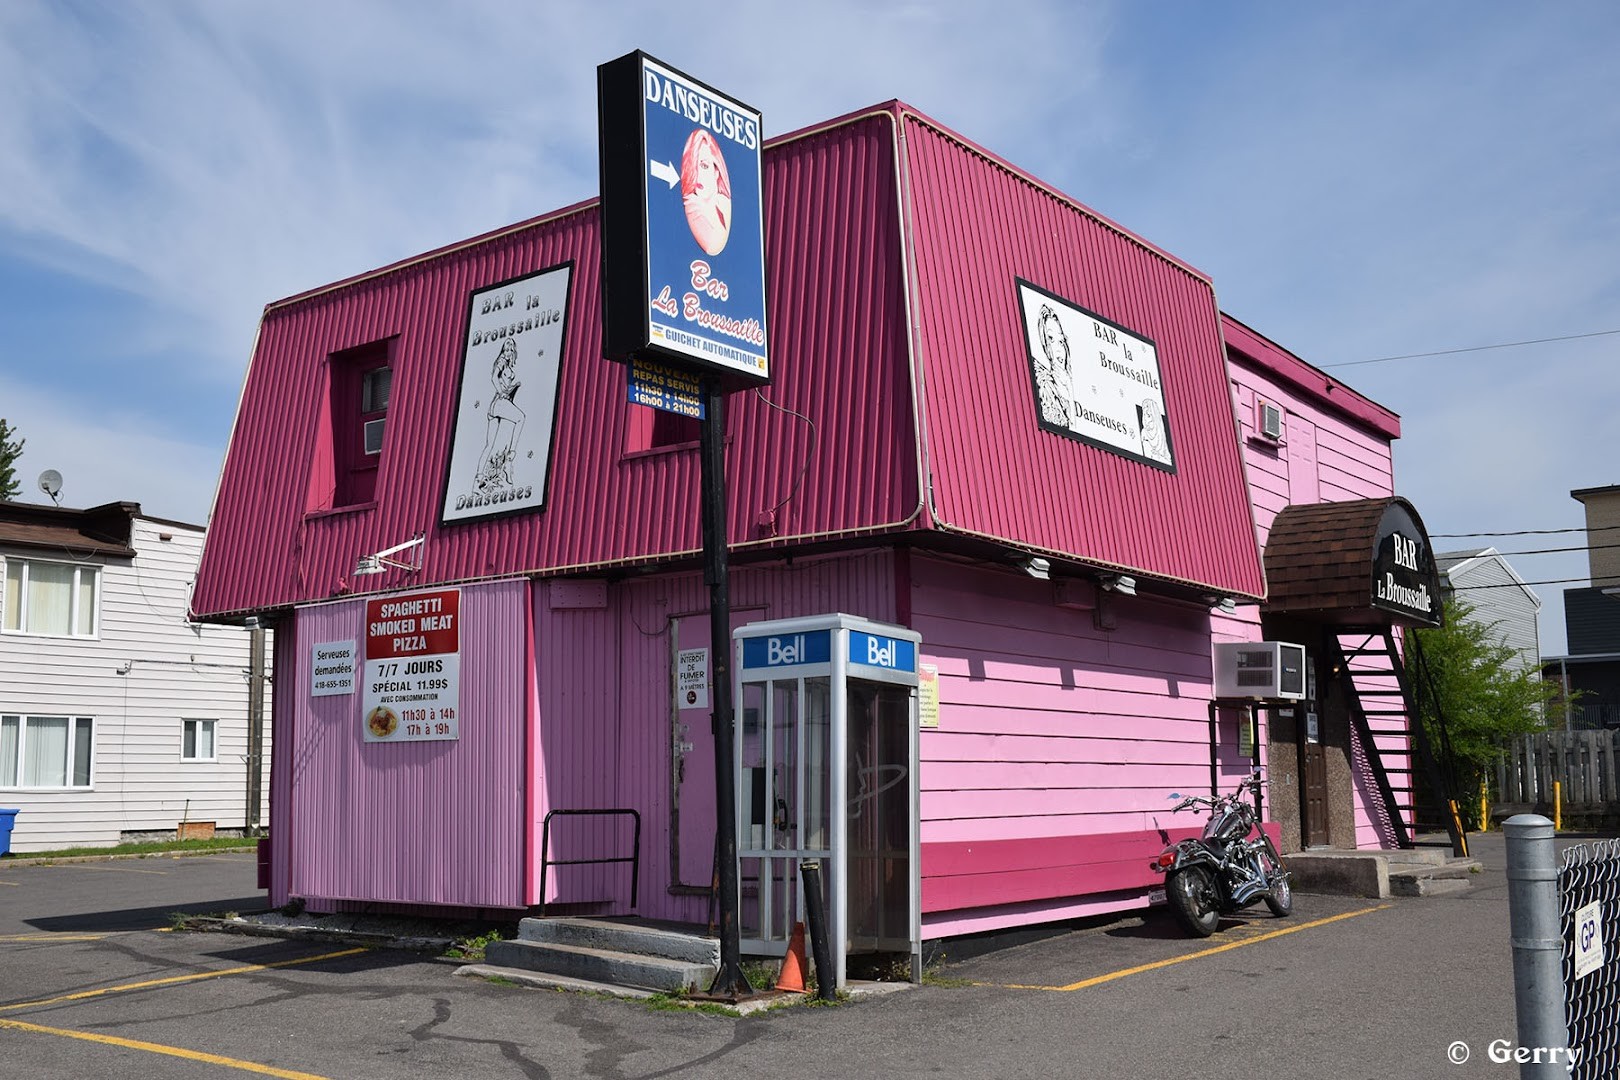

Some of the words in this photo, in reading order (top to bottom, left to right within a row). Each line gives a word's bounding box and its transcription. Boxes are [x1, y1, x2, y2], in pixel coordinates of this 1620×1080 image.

[645, 70, 757, 150] DANSEUSES
[690, 260, 729, 301] Bar
[481, 291, 514, 315] BAR
[526, 294, 540, 311] la
[472, 308, 560, 347] Broussaille
[652, 285, 678, 318] La
[683, 292, 765, 347] Broussaille
[665, 329, 701, 348] GUICHET
[702, 341, 757, 366] AUTOMATIQUE
[1093, 321, 1118, 347] BAR
[1123, 343, 1133, 362] la
[633, 369, 664, 385] REPAS
[667, 379, 700, 394] SERVIS
[1099, 351, 1159, 390] Broussaille
[634, 381, 663, 396] 11h30
[634, 392, 663, 407] 16h00
[673, 402, 700, 417] 21h00
[1073, 400, 1128, 435] Danseuses
[455, 485, 532, 511] Danseuses
[1392, 533, 1418, 571] BAR
[1377, 580, 1386, 599] La
[1386, 572, 1432, 612] Broussaille
[381, 598, 442, 618] SPAGHETTI
[370, 619, 416, 637] SMOKED
[421, 614, 453, 632] MEAT
[317, 649, 350, 660] Serveuses
[393, 635, 427, 652] PIZZA
[767, 635, 805, 665] Bell
[867, 635, 896, 668] Bell
[315, 662, 352, 676] demandées
[378, 663, 398, 678] 7/7
[404, 660, 443, 675] JOURS
[680, 655, 705, 664] INTERDIT
[372, 680, 412, 693] SPÉCIAL
[417, 678, 448, 689] 11.99$
[680, 671, 705, 680] FUMER
[395, 693, 438, 702] CONSOMMATION
[402, 709, 426, 721] 11h30
[430, 708, 435, 720] à
[440, 707, 455, 720] 14h
[407, 724, 421, 735] 17h
[425, 723, 430, 735] à
[434, 723, 449, 734] 19h
[1581, 919, 1595, 953] GP
